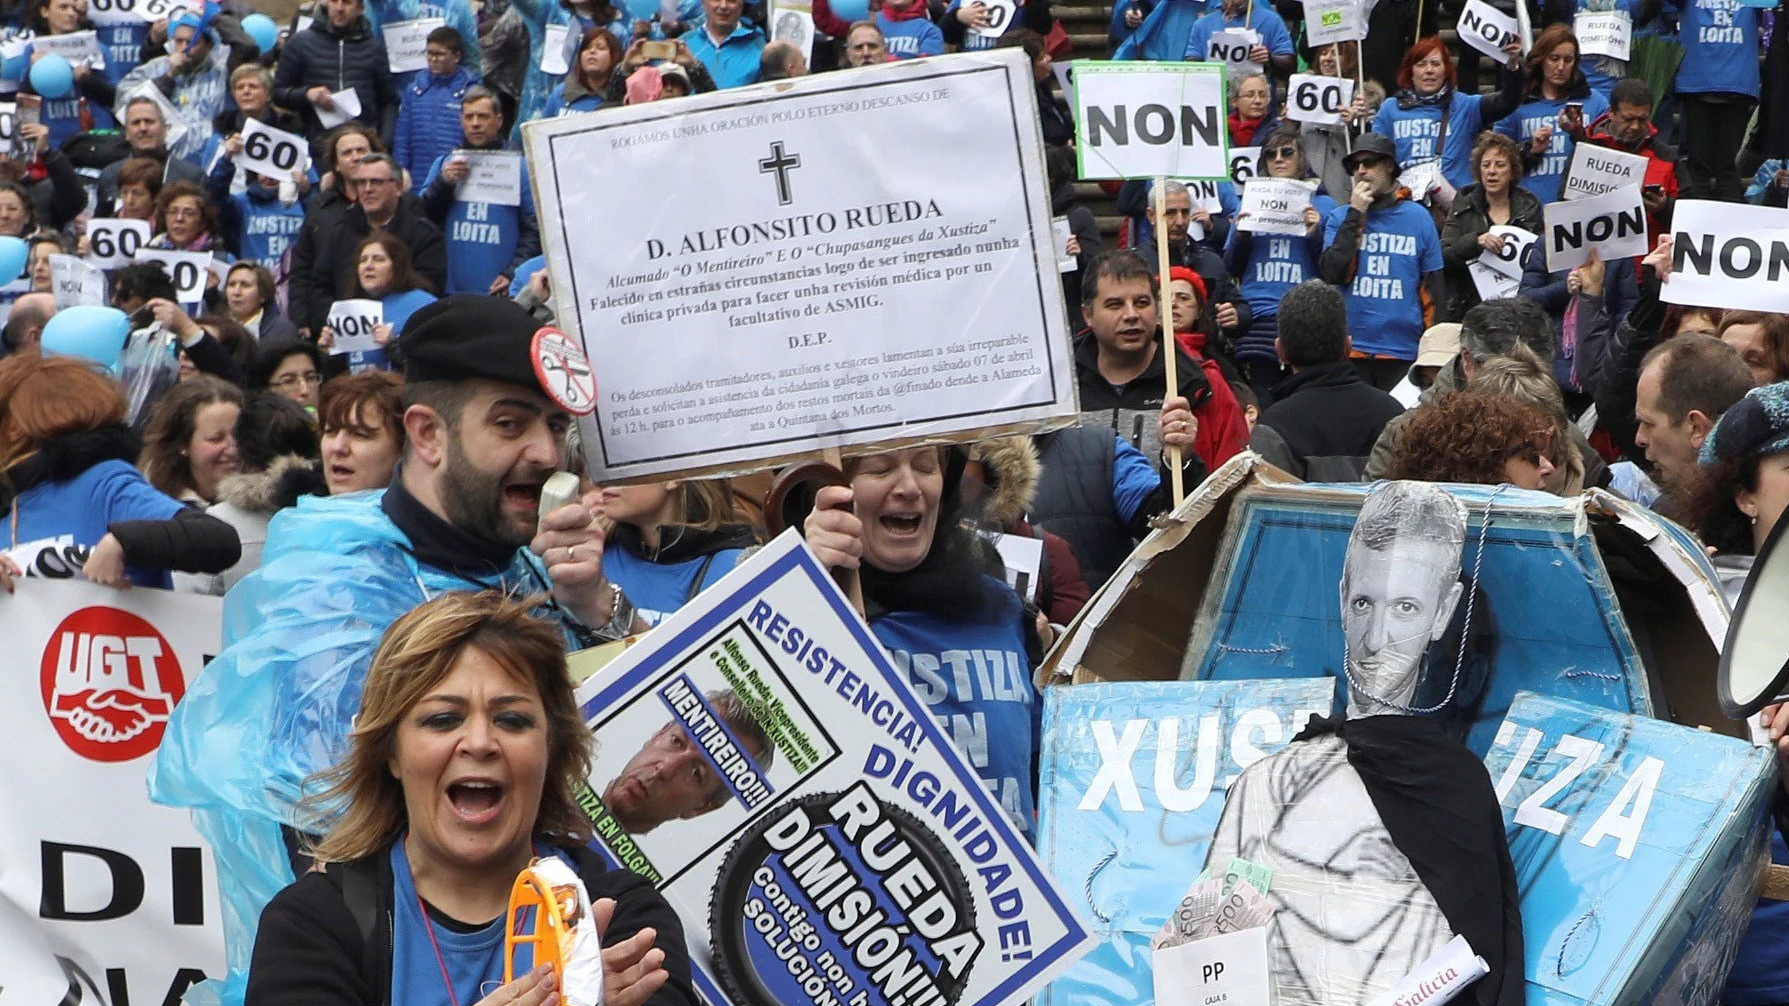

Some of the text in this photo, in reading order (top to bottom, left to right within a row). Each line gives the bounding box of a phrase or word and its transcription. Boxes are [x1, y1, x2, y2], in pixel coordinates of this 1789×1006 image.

[1699, 27, 1743, 44] LOITA
[1296, 82, 1342, 114] 60
[1086, 103, 1219, 147] NON
[245, 131, 299, 170] 60
[1587, 158, 1631, 177] RUEDA
[466, 202, 489, 222] EN
[1260, 199, 1288, 211] NON
[91, 227, 142, 258] 60
[453, 221, 500, 244] LOITA
[647, 199, 942, 260] D. ALFONSITO RUEDA
[1554, 206, 1644, 252] NON
[606, 270, 669, 290] Alcumado
[777, 250, 787, 262] E
[791, 248, 802, 260] O
[918, 229, 935, 240] da
[1269, 239, 1291, 259] EN
[1367, 255, 1390, 276] EN
[591, 237, 1019, 311] Falecido en estrañas circunstancias logo de ser ingresado nunha
[1256, 262, 1302, 284] LOITA
[621, 261, 992, 326] clínica privada para facer unha revisión médica por un
[729, 294, 883, 328] facultativo de ASMIG.
[789, 332, 832, 349] D.E.P.
[55, 632, 164, 698] UGT
[722, 637, 751, 672] Alfonso
[747, 599, 927, 753] RESISTENCIA!
[664, 678, 772, 809] MENTIREIRO!!!
[598, 815, 618, 838] EN
[863, 744, 1034, 964] DIGNIDADE!
[39, 839, 204, 925] DI
[829, 783, 981, 979] RUEDA
[753, 865, 820, 950] Contigo
[818, 948, 854, 994] non
[1202, 962, 1225, 984] PP
